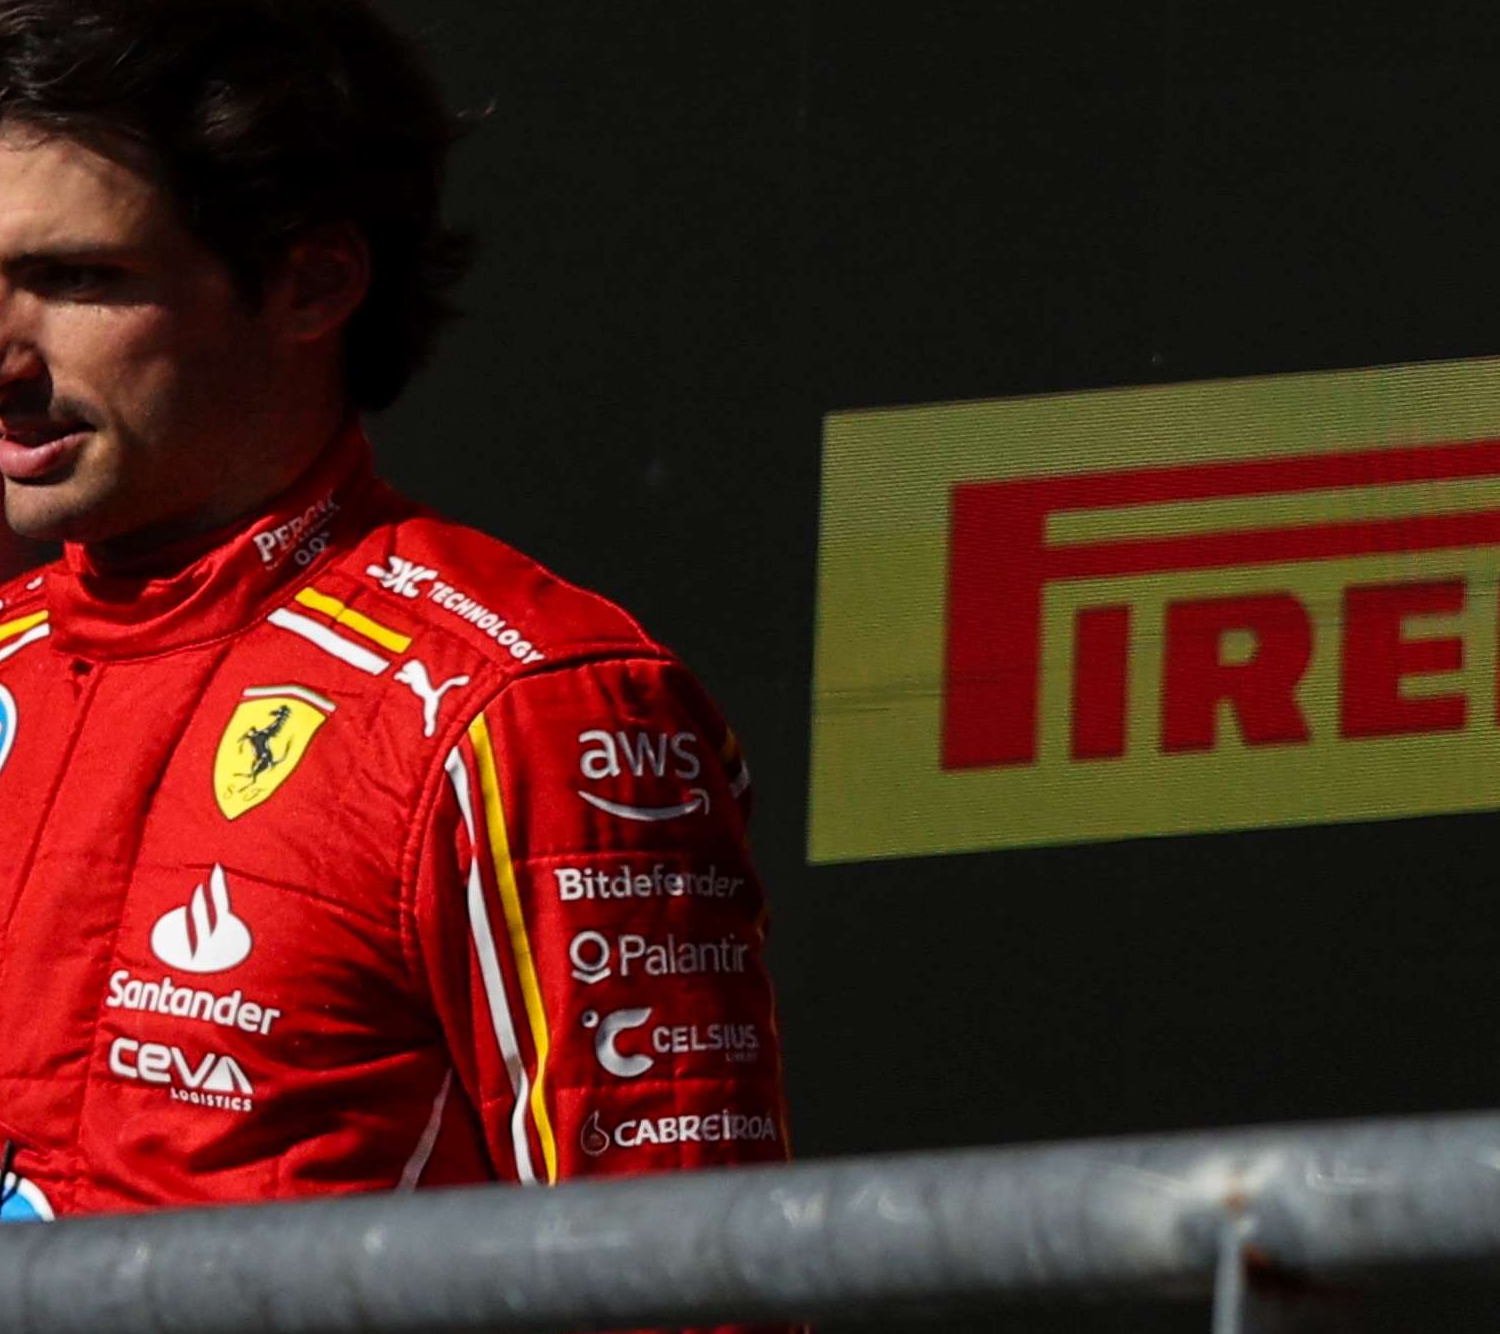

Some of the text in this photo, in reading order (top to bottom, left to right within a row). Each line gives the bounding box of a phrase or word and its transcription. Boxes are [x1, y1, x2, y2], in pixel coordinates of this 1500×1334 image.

[427, 581, 546, 665] TECHNOLOGY
[578, 729, 700, 779] aws
[554, 864, 744, 901] Bitdefender
[618, 933, 750, 977] Palantir
[105, 969, 281, 1035] Santander
[651, 1023, 759, 1053] CELSIUS
[170, 1087, 253, 1112] LOGISTICS
